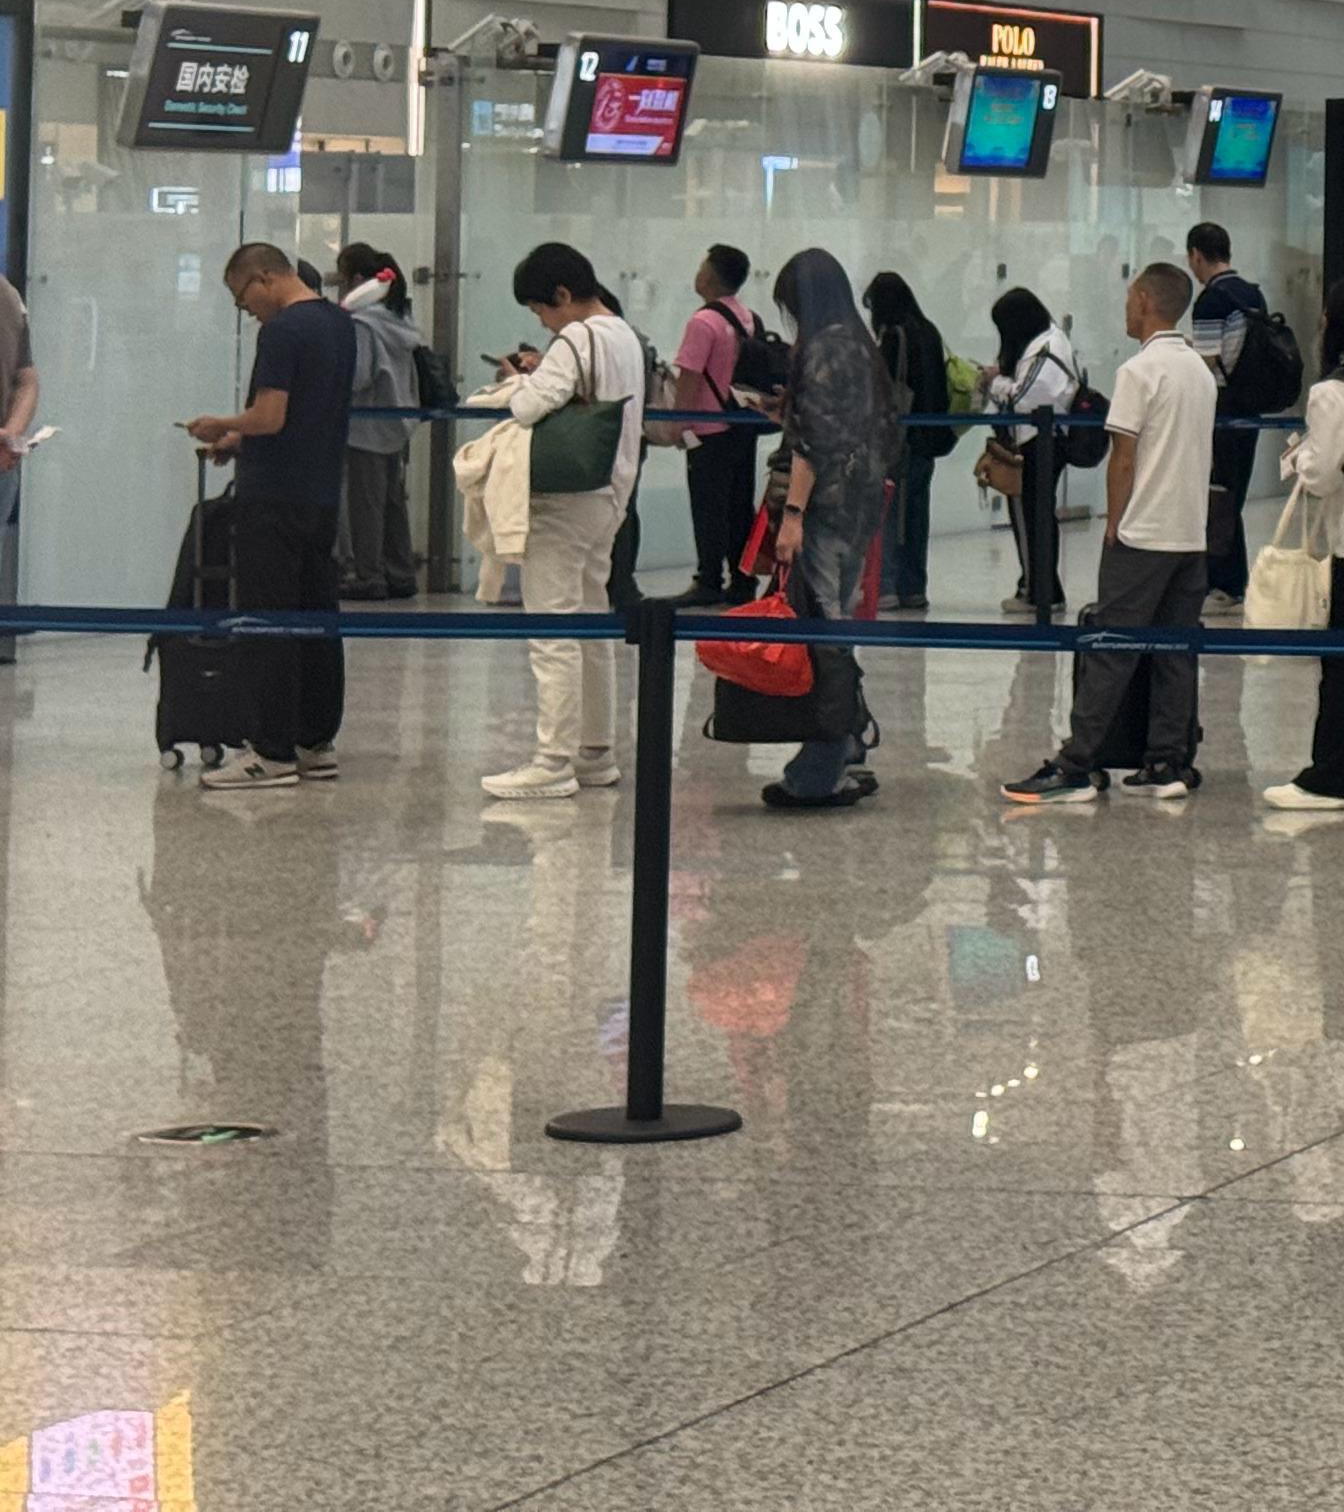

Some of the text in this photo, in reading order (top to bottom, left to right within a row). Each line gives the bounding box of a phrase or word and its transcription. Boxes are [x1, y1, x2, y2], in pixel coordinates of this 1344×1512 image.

[766, 0, 844, 57] BOSS
[991, 23, 1036, 56] POLO
[288, 31, 309, 63] 11
[176, 61, 249, 94] 国内安检
